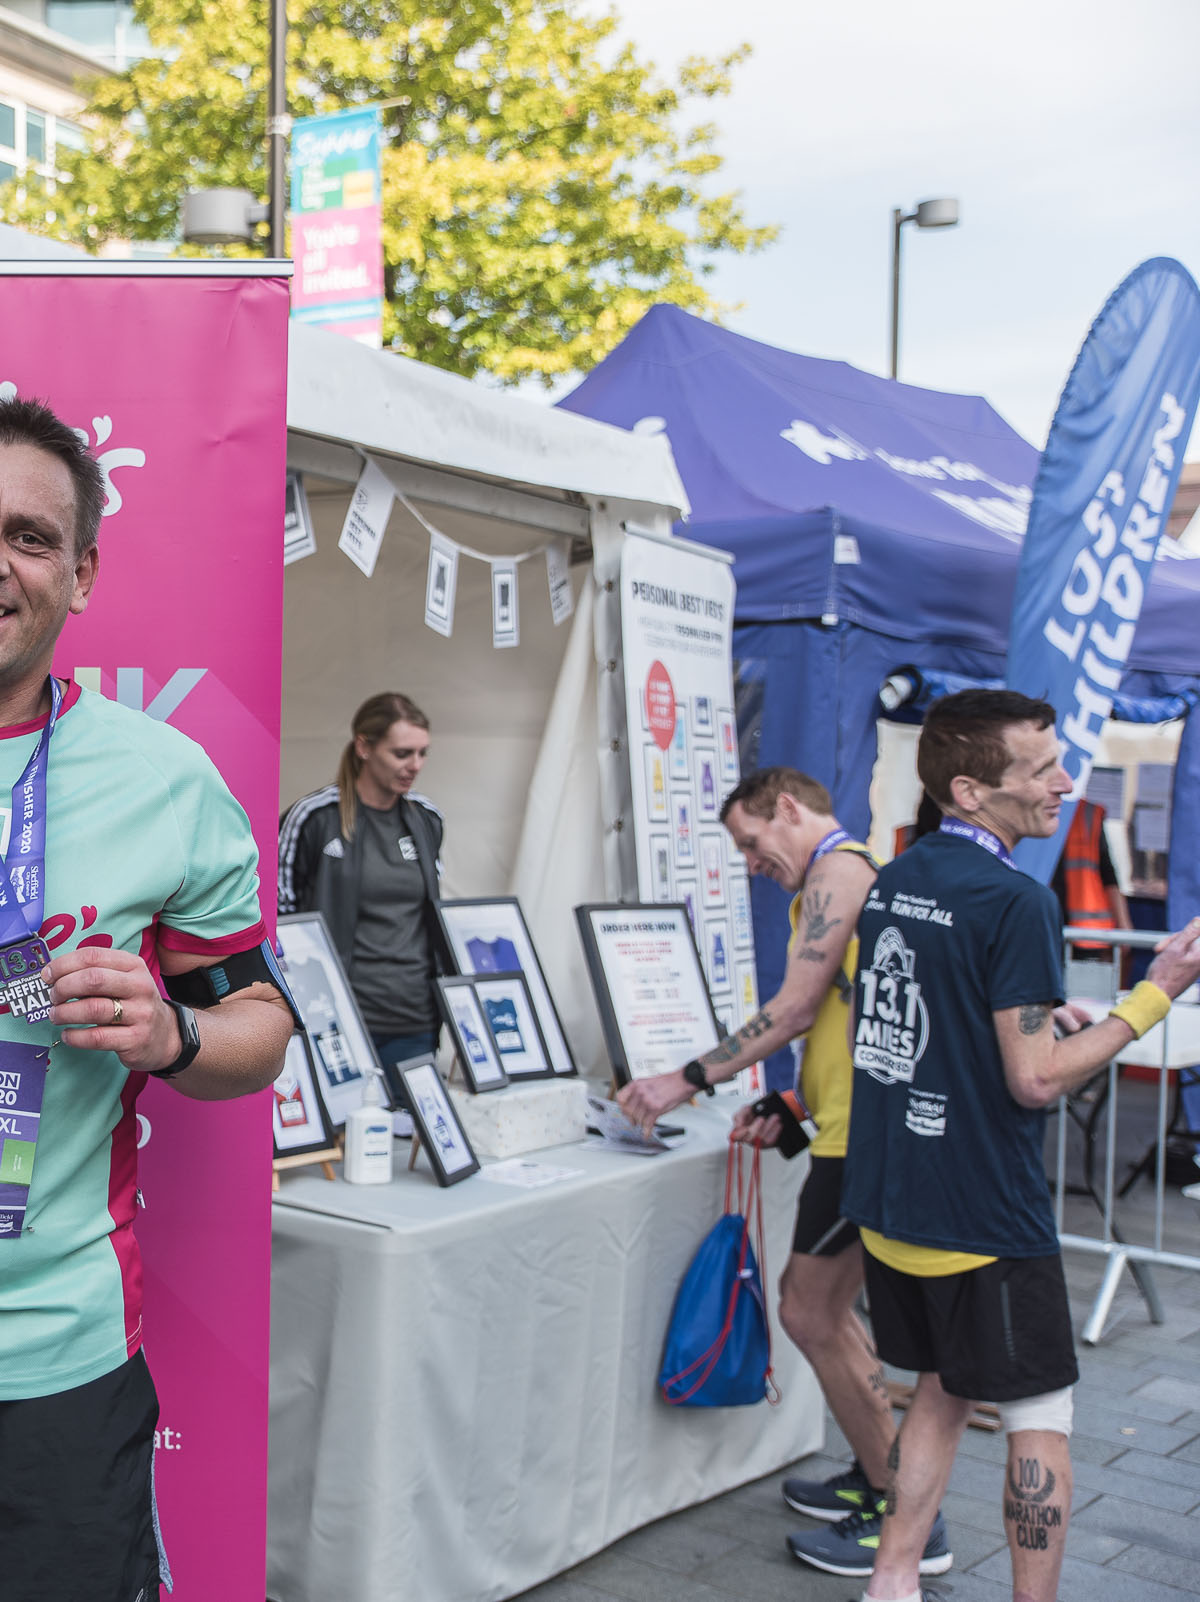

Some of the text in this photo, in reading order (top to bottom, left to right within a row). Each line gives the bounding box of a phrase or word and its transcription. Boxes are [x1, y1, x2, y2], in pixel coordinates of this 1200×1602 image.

[1057, 391, 1186, 802] CHILDREN
[20, 764, 39, 854] FINISHER 2020
[30, 865, 39, 900] Sheffield
[9, 988, 52, 1017] HAL
[860, 969, 921, 1029] 13.1
[1018, 1457, 1040, 1489] 100
[1016, 1524, 1048, 1551] CLUB
